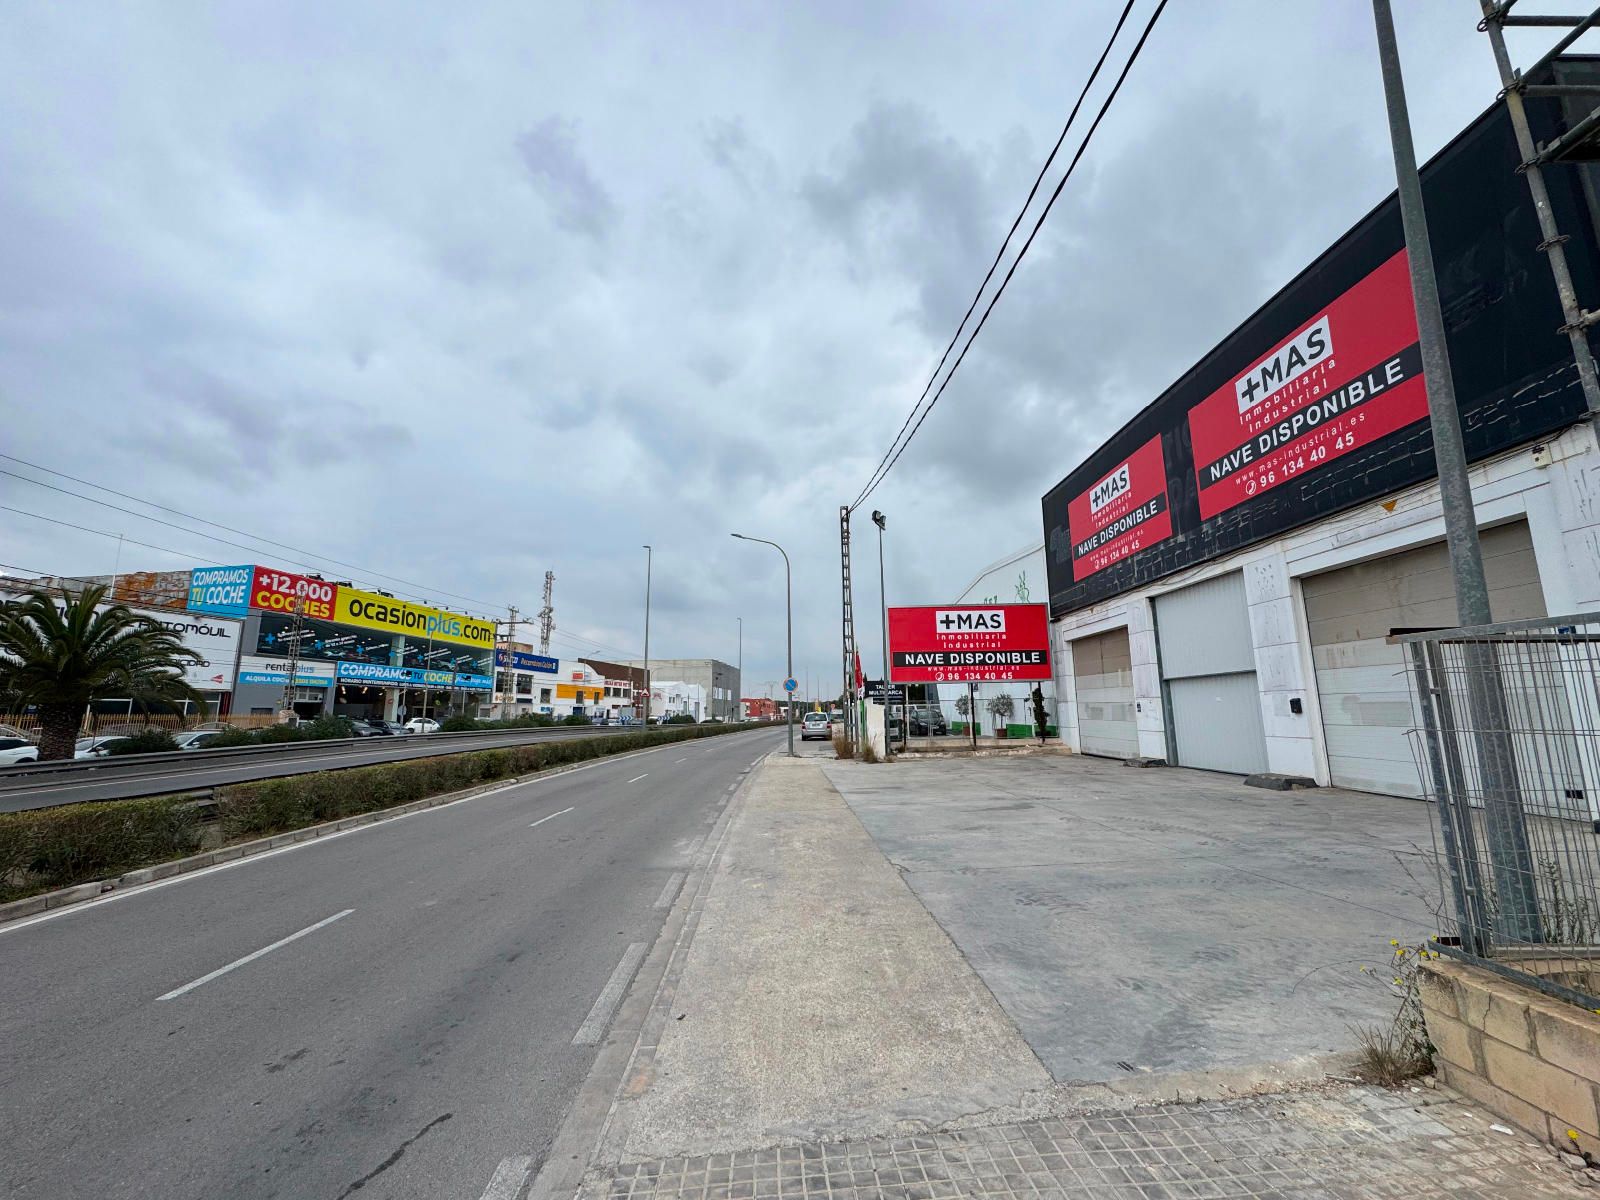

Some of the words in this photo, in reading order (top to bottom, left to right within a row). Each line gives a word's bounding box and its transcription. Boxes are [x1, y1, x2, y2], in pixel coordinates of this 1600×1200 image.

[1241, 328, 1326, 403] +MAS
[1210, 444, 1253, 482] NAVE
[1258, 358, 1404, 453] DISPONIBLE
[1235, 413, 1365, 485] www.mas-industrial.es
[1260, 471, 1275, 488] 96
[1282, 456, 1304, 477] 134
[1310, 446, 1326, 463] 40
[1335, 432, 1354, 450] 45
[1092, 470, 1128, 508] +MAS
[1078, 535, 1099, 556] NAVE
[1100, 500, 1158, 544] DISPONIBLE
[1110, 550, 1120, 561] 134
[1121, 545, 1129, 555] 40
[1131, 539, 1140, 550] 45
[193, 569, 249, 585] COMPRAMOS
[260, 573, 332, 602] +12.000
[191, 588, 206, 606] TU
[206, 586, 246, 604] COCHE
[349, 599, 491, 643] ocasionplus.com
[940, 613, 1002, 630] +MAS
[905, 653, 944, 665] NAVE
[950, 652, 1040, 664] DISPONIBLE
[413, 671, 423, 680] TU
[947, 672, 960, 680] 96
[964, 672, 981, 680] 134
[984, 672, 996, 680] 40
[1001, 672, 1013, 680] 45
